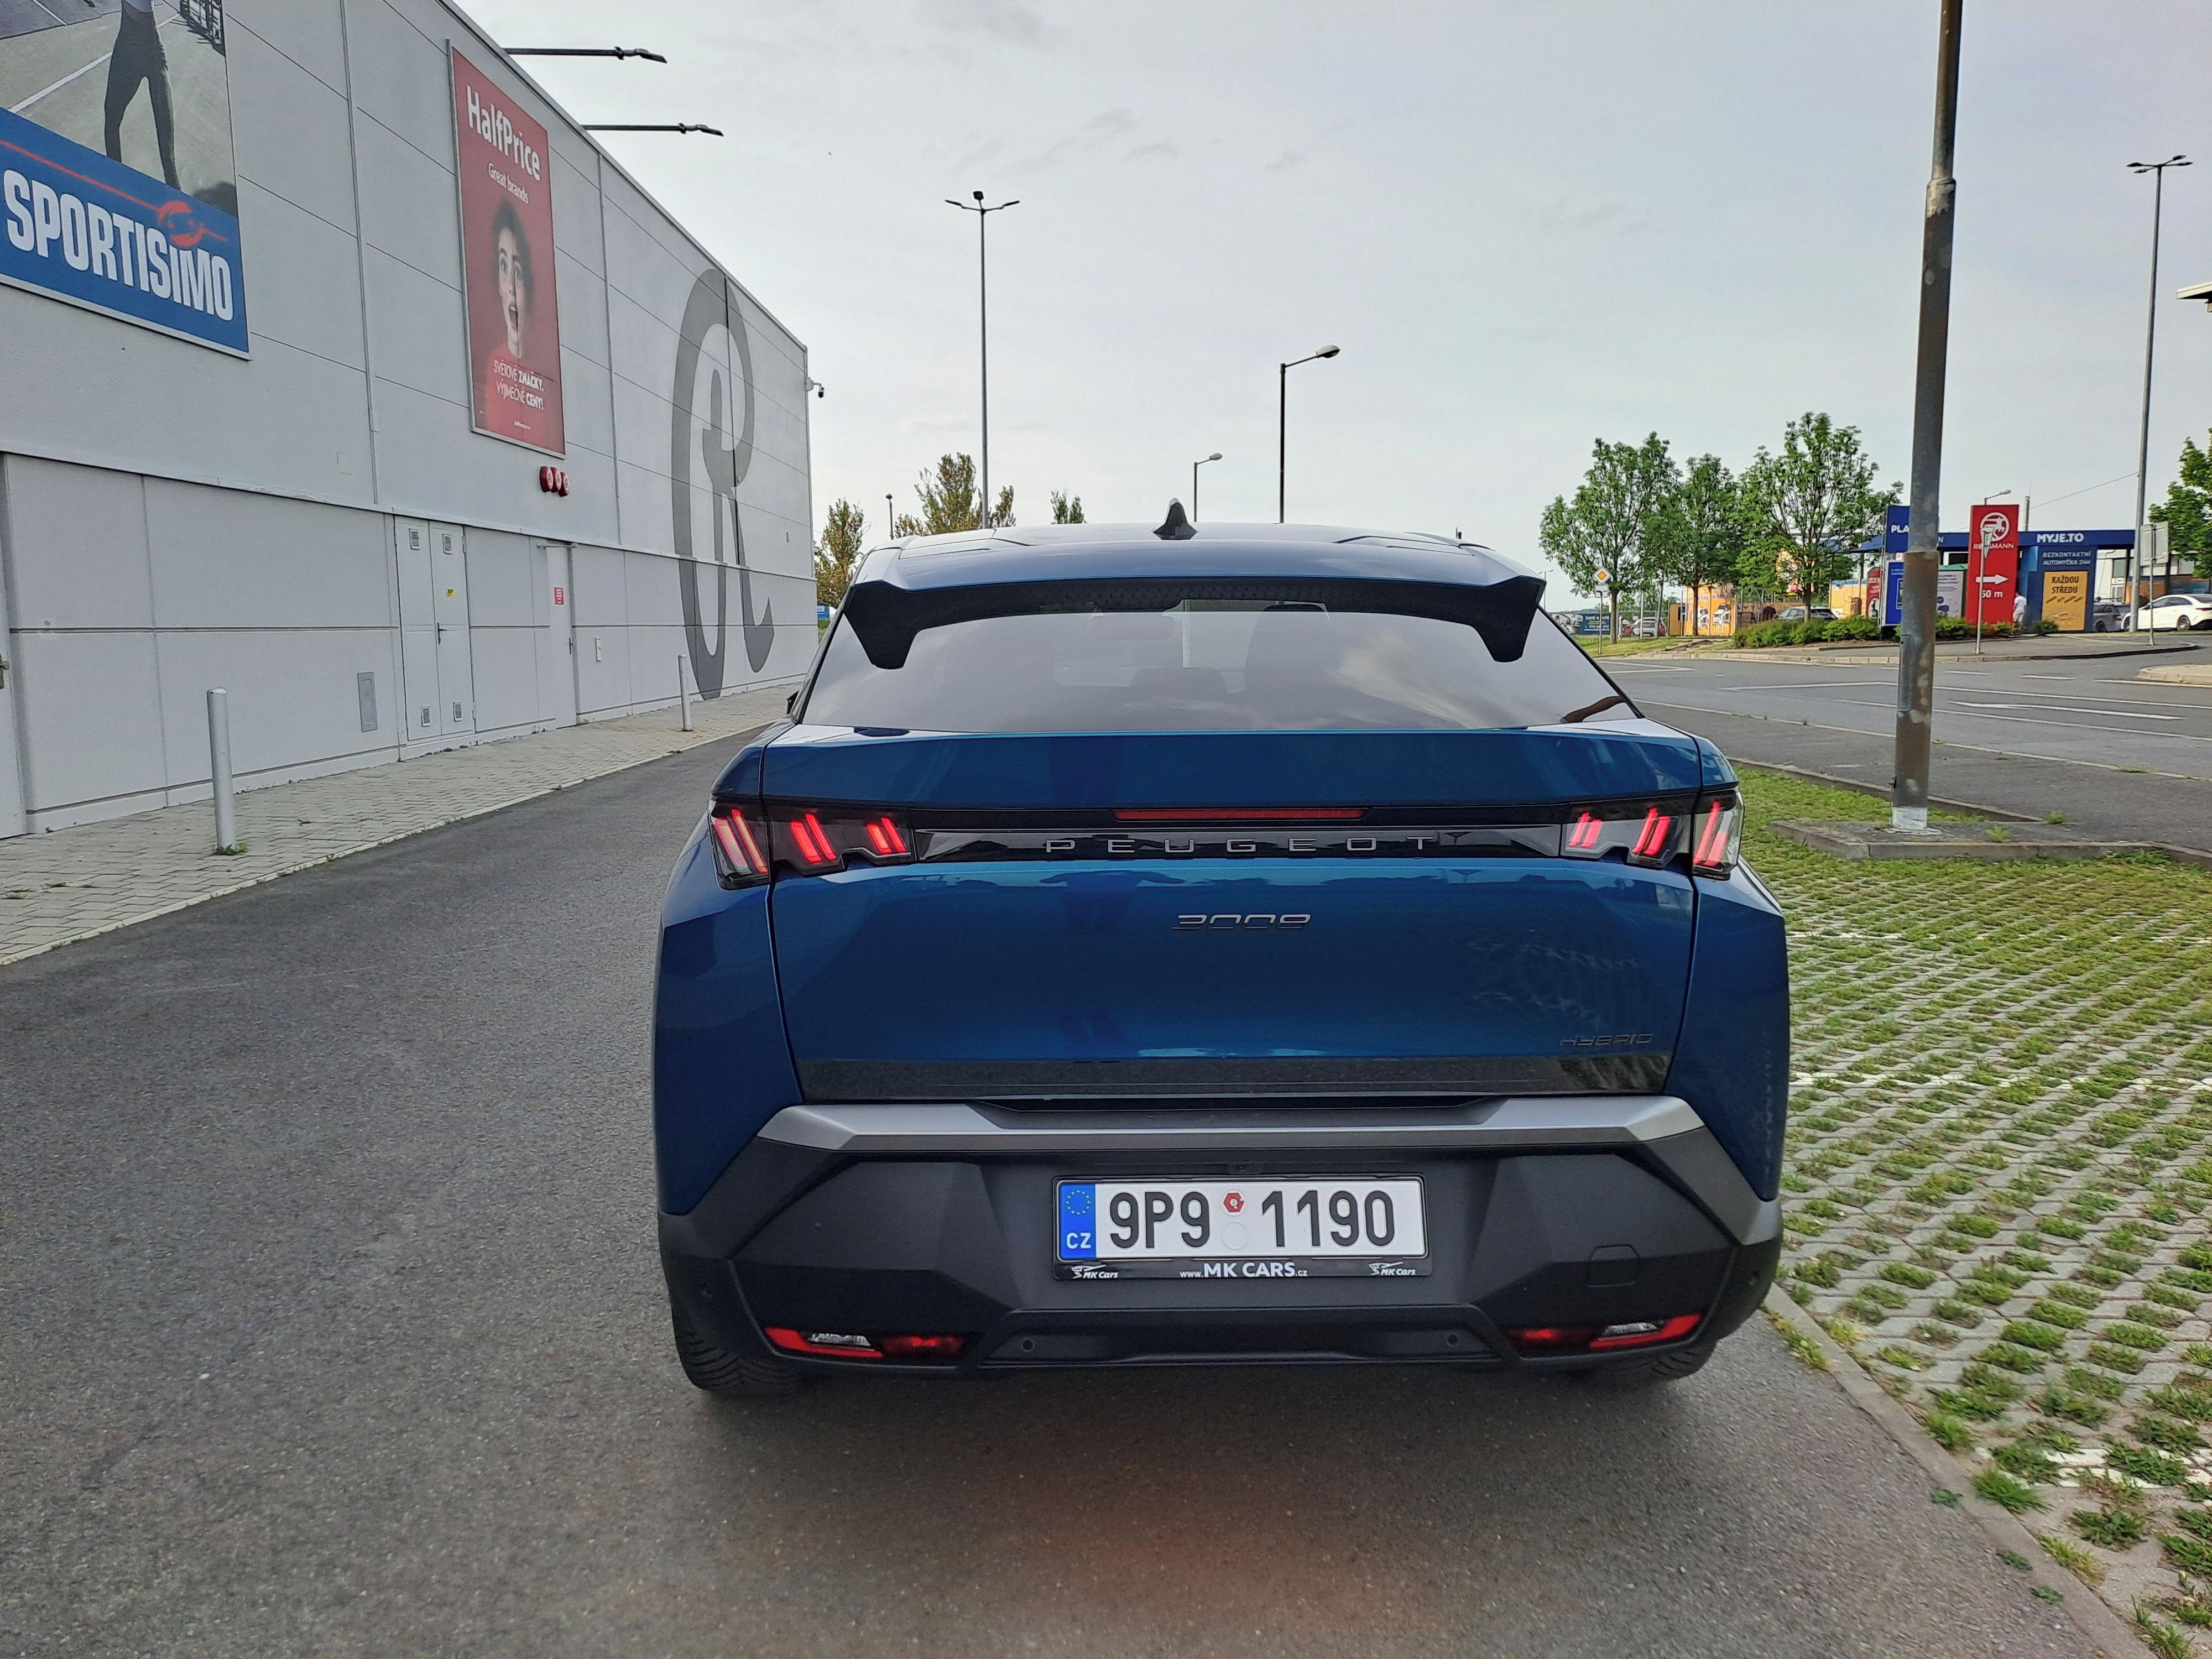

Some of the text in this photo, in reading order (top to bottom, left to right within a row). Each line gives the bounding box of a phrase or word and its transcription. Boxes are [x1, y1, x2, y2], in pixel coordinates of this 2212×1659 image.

[466, 85, 541, 181] HalfPrice
[488, 163, 529, 204] Great brands
[3, 169, 234, 321] SPORTISIMO
[526, 392, 544, 411] CENY!
[2037, 533, 2084, 543] MYJE.TO
[2052, 575, 2079, 583] KAŽDOU
[1981, 589, 1991, 598] 50
[2052, 586, 2078, 594] STŘEDU
[1045, 836, 1434, 853] PEUGEOT
[1172, 914, 1311, 929] 3008
[1559, 1034, 1653, 1046] HYBRID
[1109, 1190, 1395, 1249] 9P9 1190
[1066, 1232, 1091, 1249] CZ
[1241, 1262, 1308, 1277] CARS.cz
